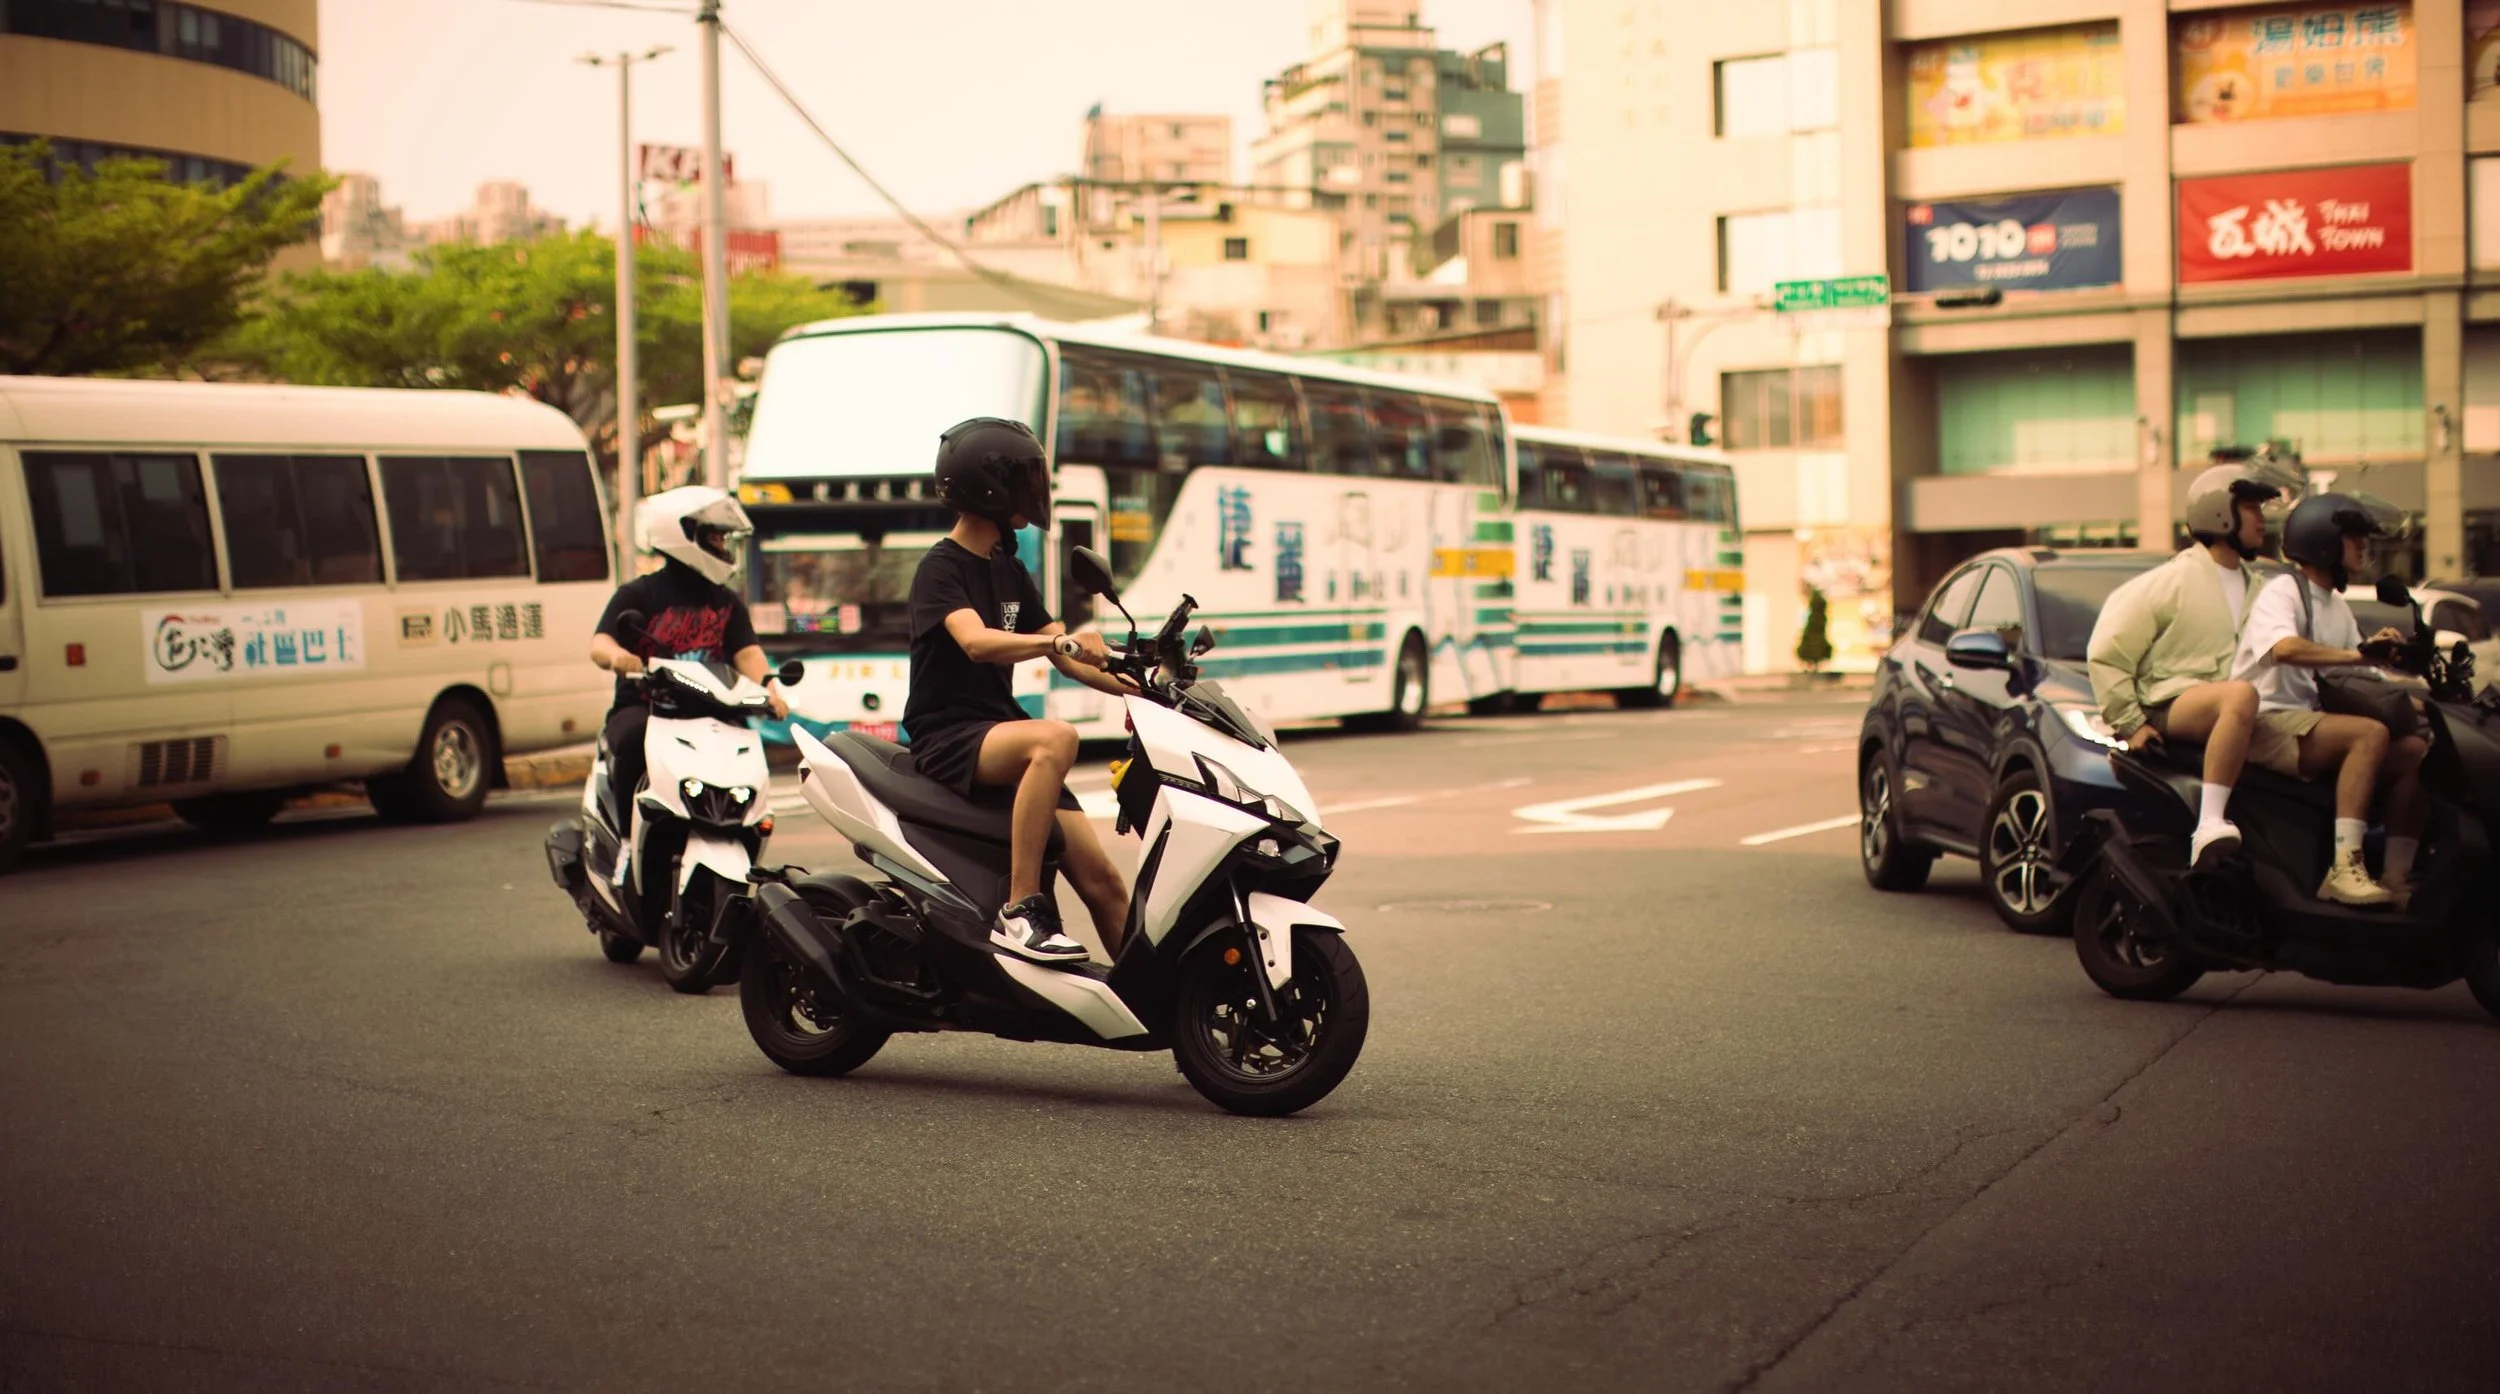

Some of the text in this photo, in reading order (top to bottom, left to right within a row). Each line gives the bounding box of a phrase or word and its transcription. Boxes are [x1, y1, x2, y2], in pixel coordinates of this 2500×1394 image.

[2318, 199, 2370, 225] THAI
[1925, 218, 2027, 263] 1010
[2317, 226, 2386, 252] TOWN
[244, 624, 360, 668] 社區巴士
